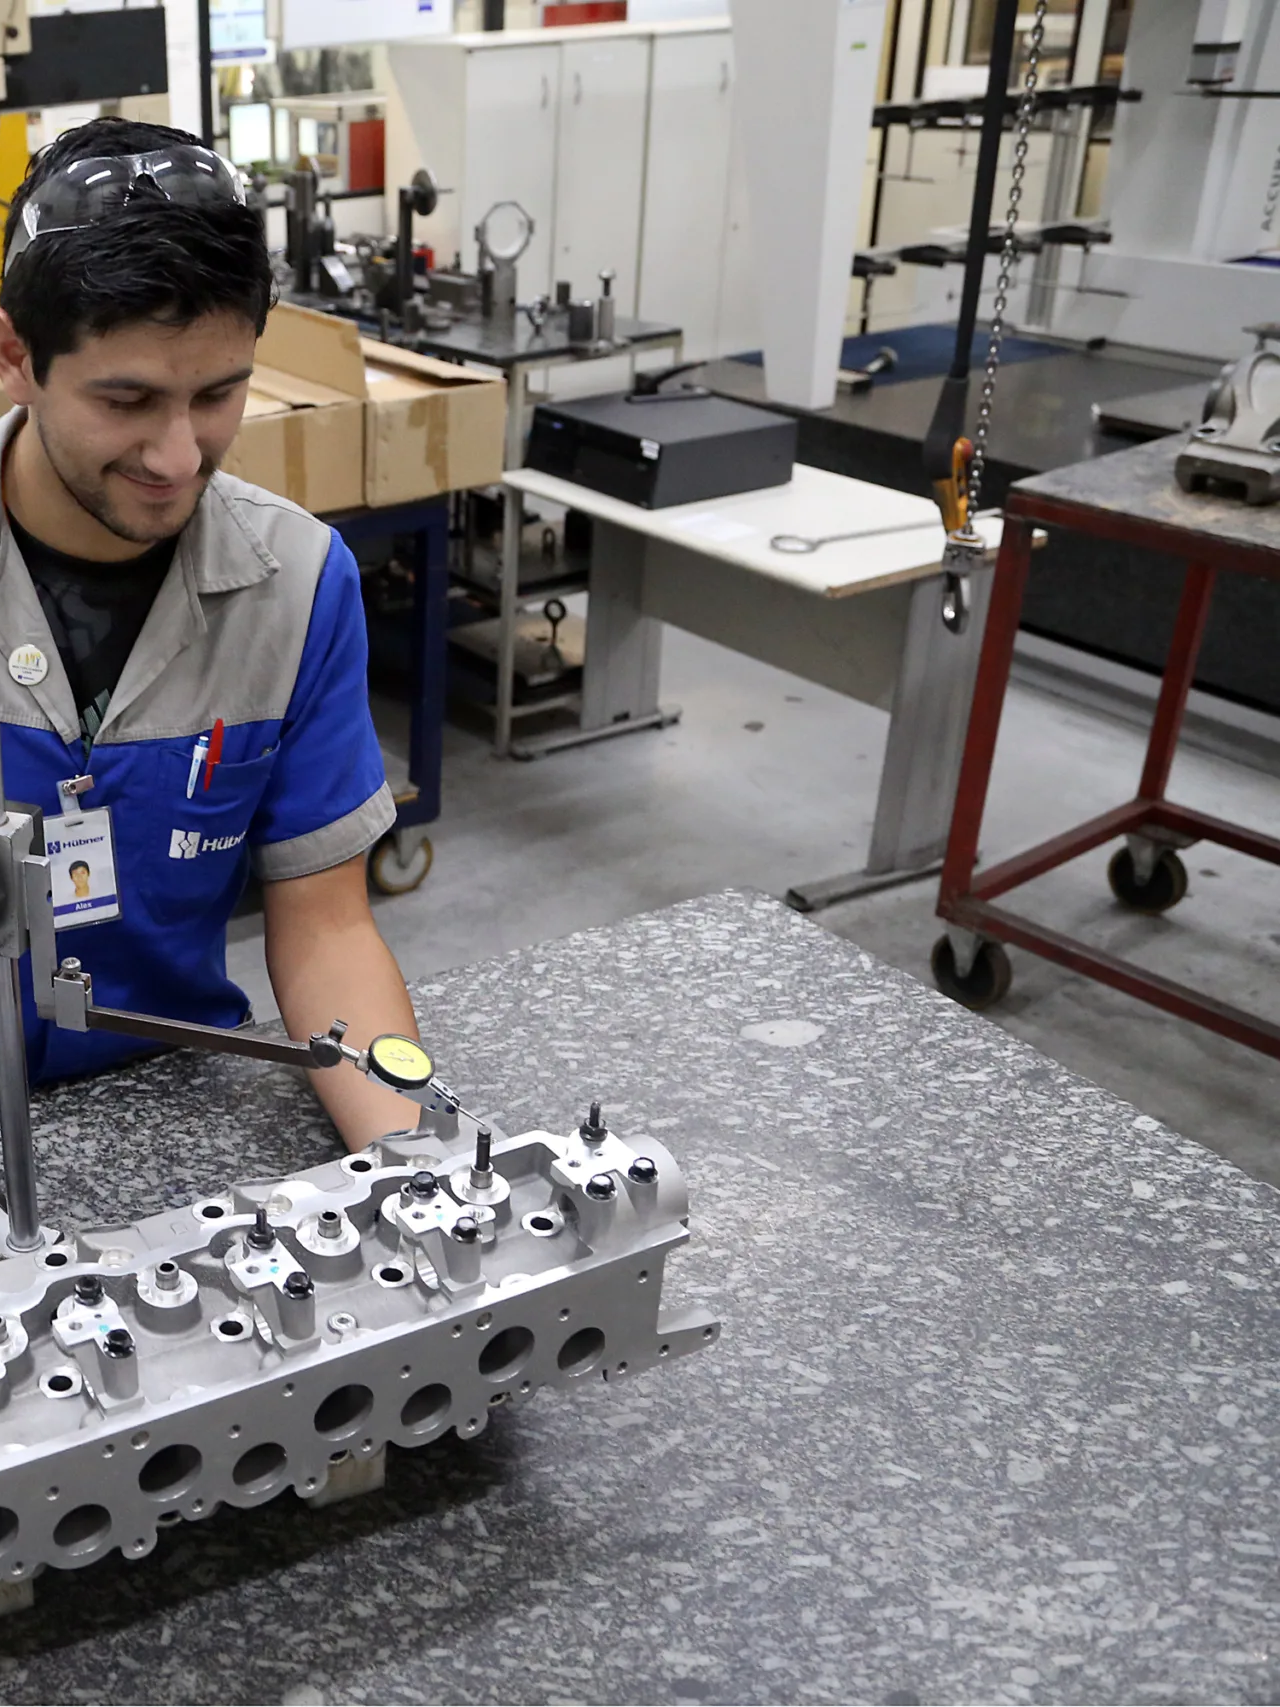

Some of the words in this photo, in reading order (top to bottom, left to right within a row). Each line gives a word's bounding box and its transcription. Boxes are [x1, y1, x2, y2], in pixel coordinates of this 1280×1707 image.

[1260, 144, 1280, 232] ACCUR
[62, 836, 105, 849] Hübner
[75, 902, 92, 910] Alex
